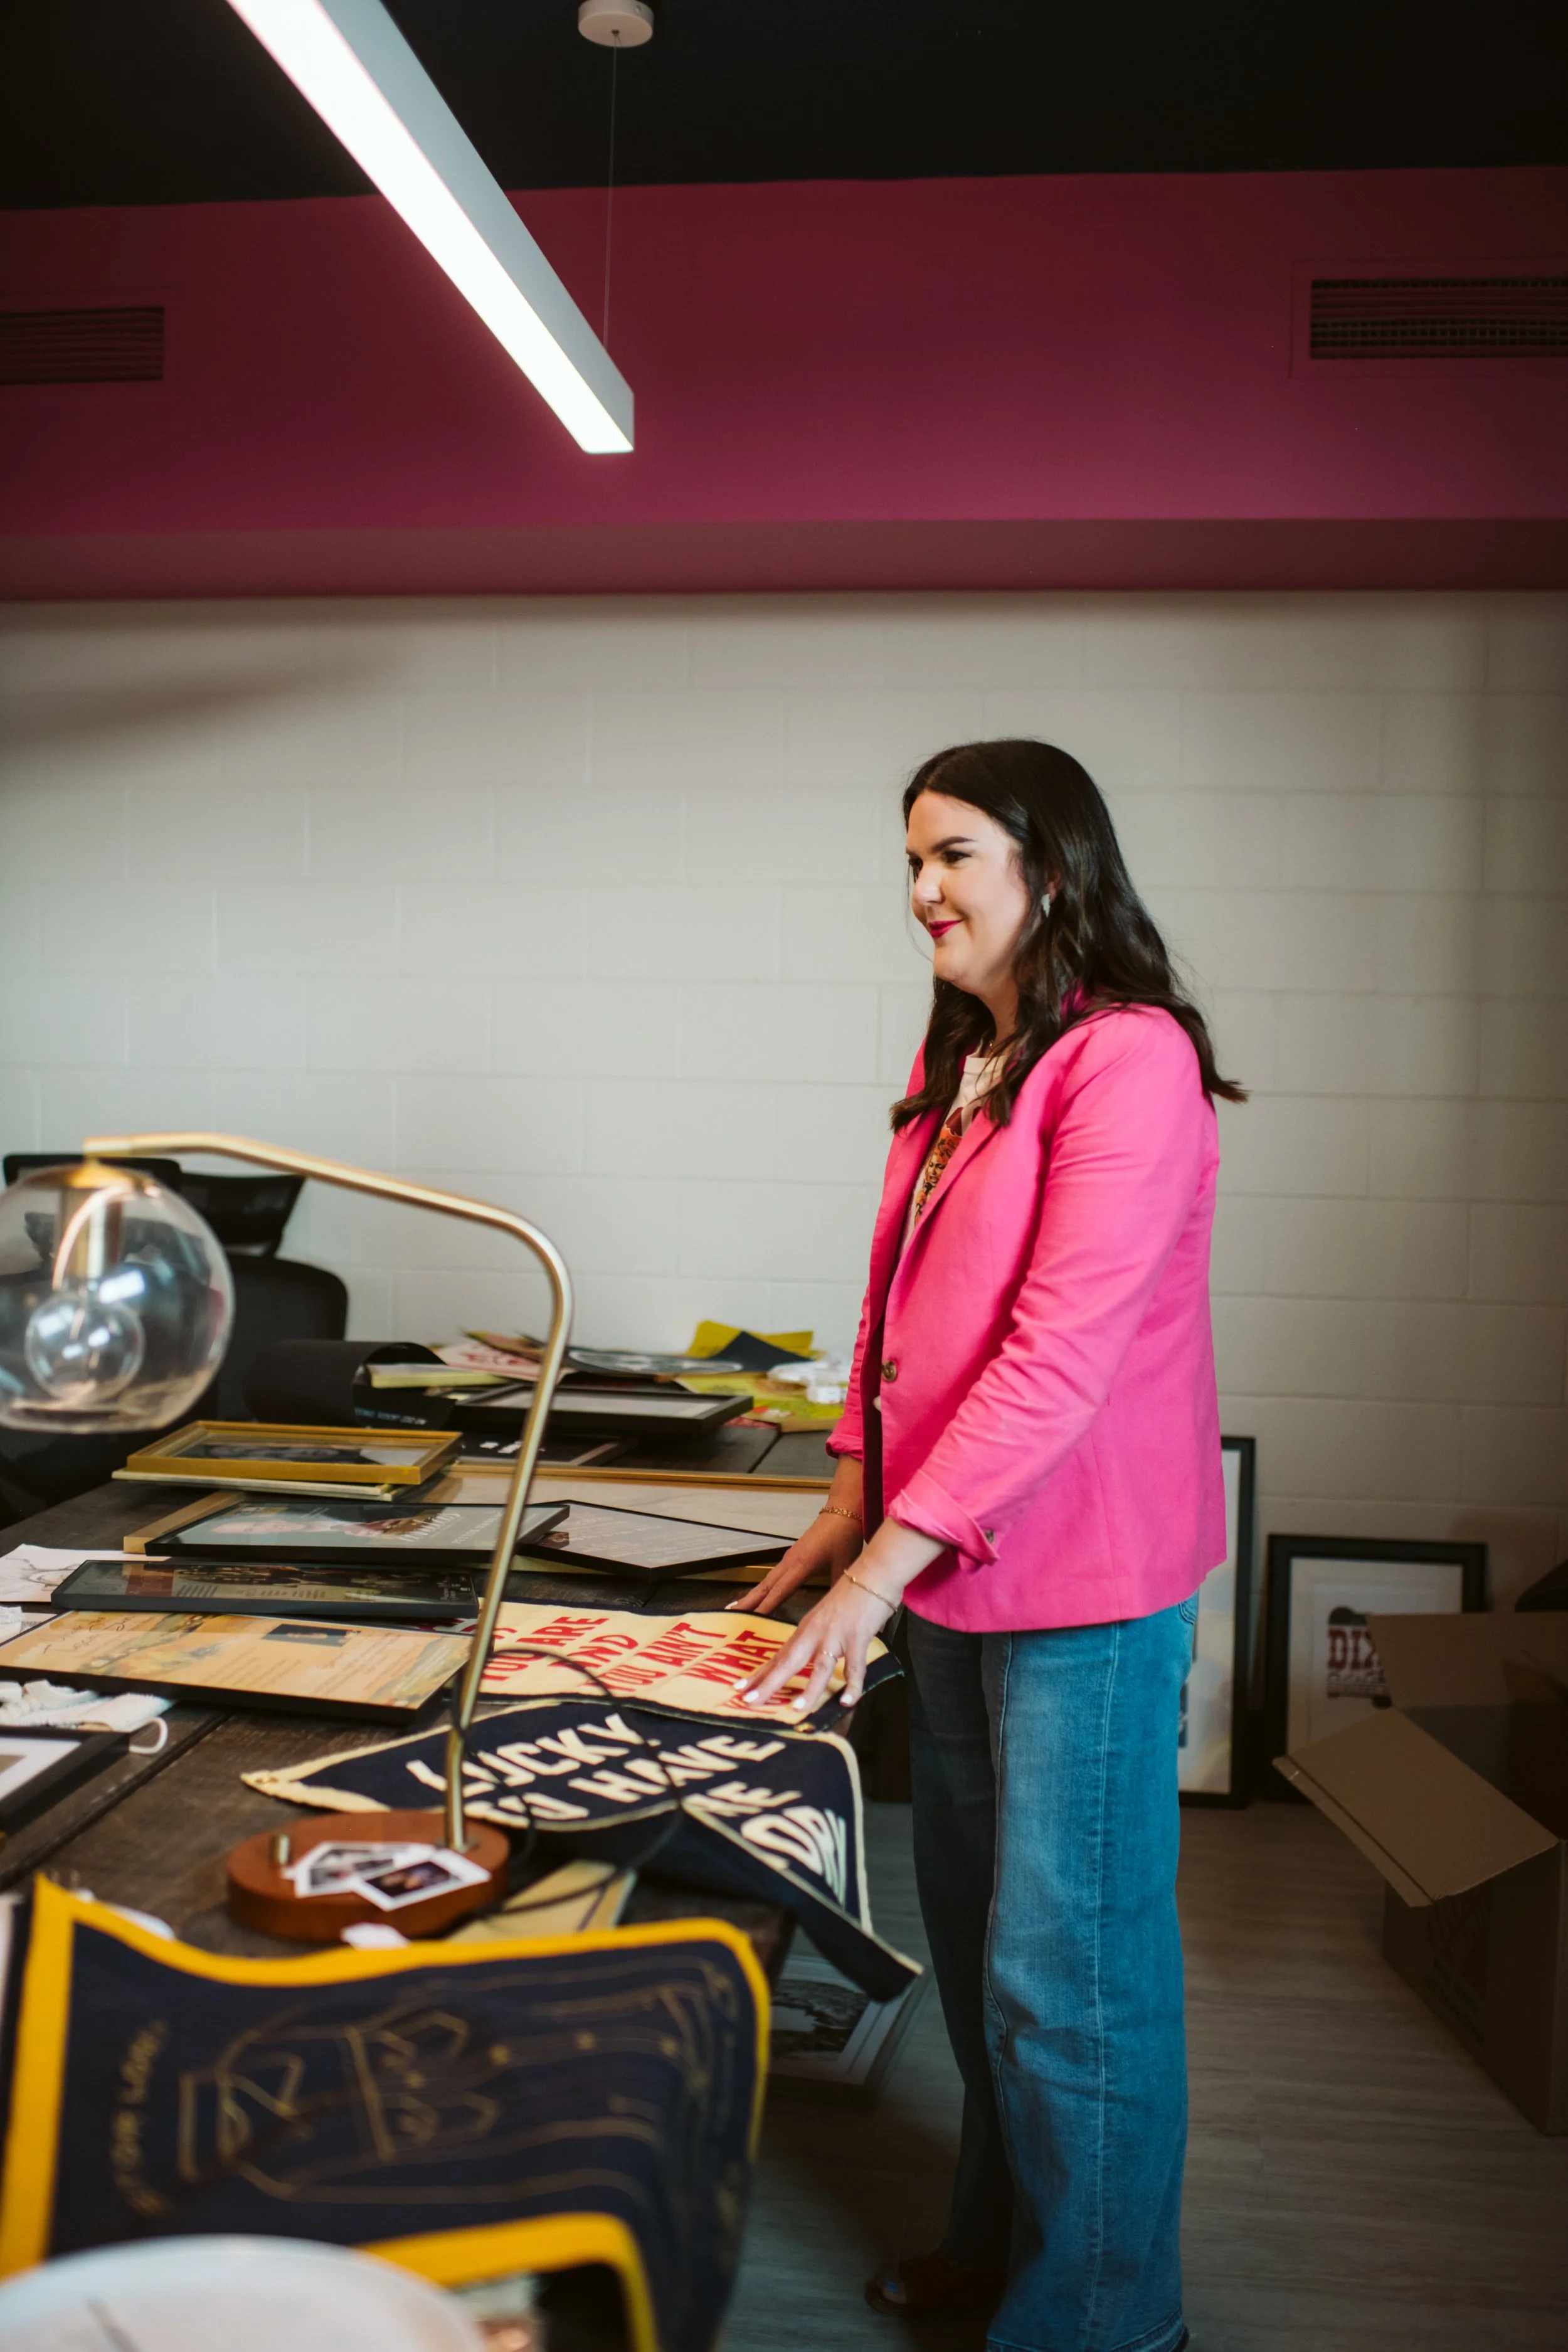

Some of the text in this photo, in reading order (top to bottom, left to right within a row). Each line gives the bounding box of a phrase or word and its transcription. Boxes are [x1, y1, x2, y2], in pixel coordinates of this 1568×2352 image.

[516, 1616, 609, 1646] ARE
[547, 1634, 638, 1674] AND
[581, 1622, 728, 1692] YOU AIN'T
[681, 1630, 785, 1686] WHAT
[405, 1713, 661, 1798] LUCKY
[567, 1734, 786, 1804] HAVE
[740, 1805, 847, 1910] ODY
